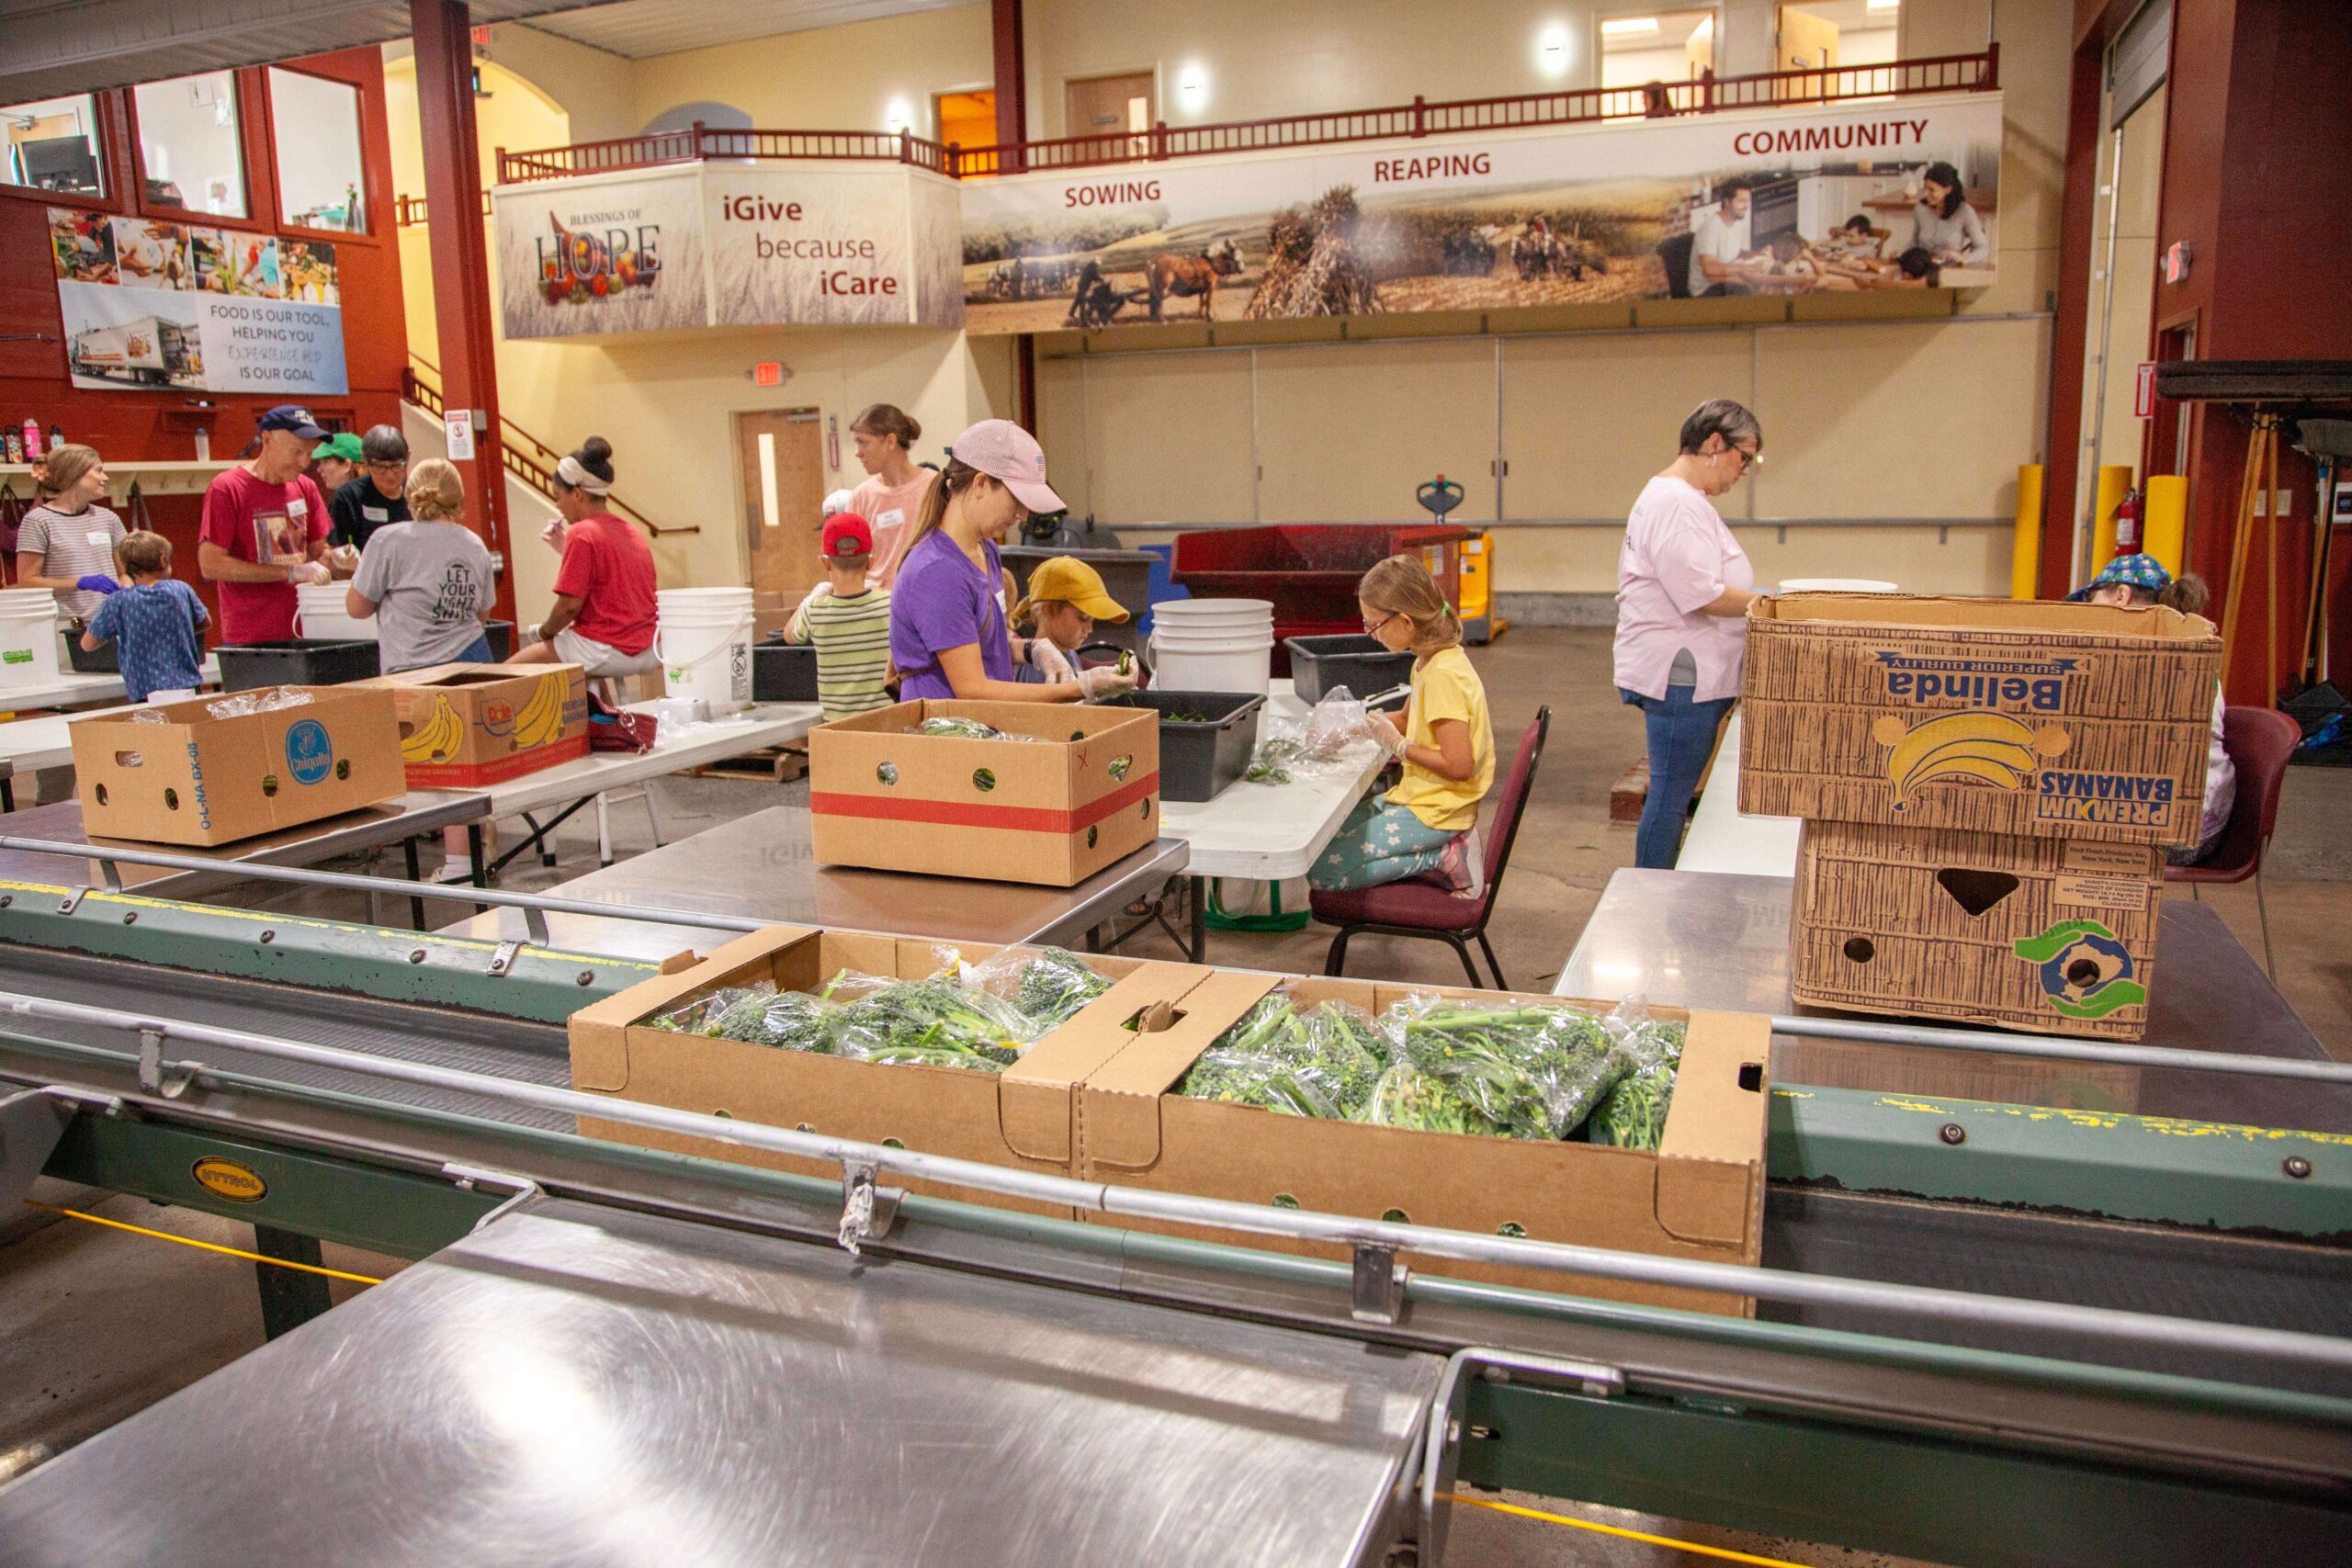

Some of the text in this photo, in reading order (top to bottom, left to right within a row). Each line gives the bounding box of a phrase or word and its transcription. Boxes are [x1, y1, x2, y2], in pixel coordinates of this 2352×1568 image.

[1734, 119, 1928, 155] COMMUNITY
[1374, 152, 1490, 182] REAPING
[1066, 181, 1160, 208] SOWING
[570, 209, 641, 226] BLESSINGS OF
[723, 195, 802, 220] iGive
[536, 225, 662, 282] HOPE
[756, 232, 875, 258] because
[820, 270, 897, 295] iCare
[210, 305, 330, 327] FOOD IS OUR TOOL,
[232, 327, 314, 343] HELPING YOU
[240, 367, 315, 381] IS OUR GOAL
[447, 569, 470, 583] LET
[438, 583, 476, 596] YOUR
[1891, 658, 2062, 675] SUPERIOR QUALITY
[1888, 671, 2063, 711] Belinda
[289, 751, 331, 772] Chiquita
[2041, 771, 2174, 802] BANANAS
